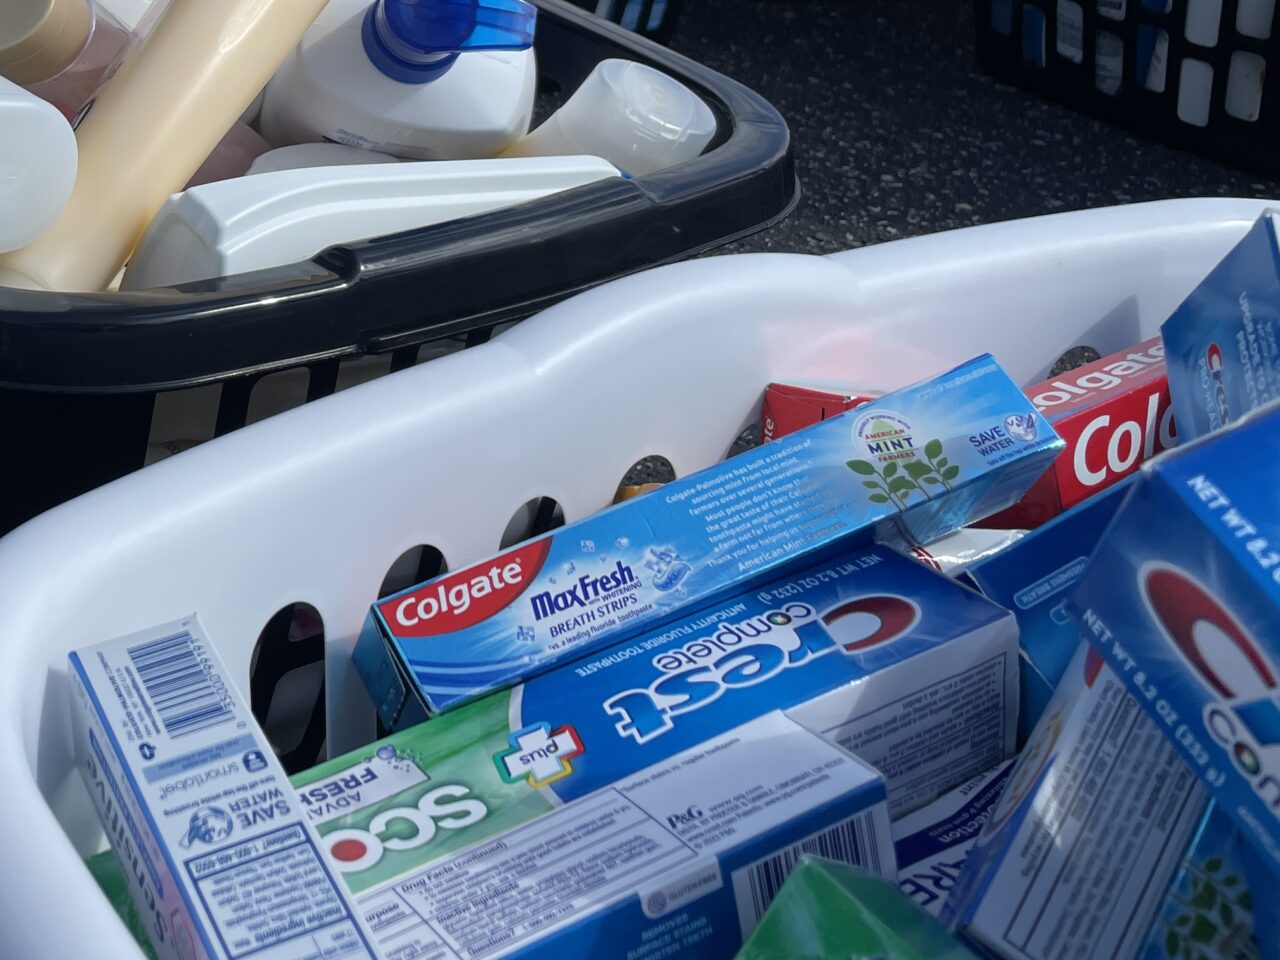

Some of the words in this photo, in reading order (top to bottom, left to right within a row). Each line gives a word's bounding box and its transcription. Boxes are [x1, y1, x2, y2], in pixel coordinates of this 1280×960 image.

[864, 427, 905, 440] AMERICAN
[867, 436, 913, 454] MINT
[967, 424, 1006, 448] SAVE
[976, 436, 1015, 457] WATER
[732, 465, 747, 476] has
[769, 442, 803, 461] tradition
[801, 438, 812, 448] of
[878, 450, 915, 463] FARMERS
[688, 498, 721, 517] farmers
[719, 492, 737, 504] over
[736, 480, 764, 497] several
[691, 486, 725, 505] sourcing
[724, 478, 743, 491] mint
[741, 471, 762, 484] from
[760, 462, 780, 475] local
[704, 509, 725, 522] Most
[724, 498, 752, 515] people
[705, 521, 721, 533] the
[720, 513, 741, 528] great
[739, 505, 761, 519] taste
[760, 501, 770, 511] of
[1185, 470, 1229, 515] NET
[1219, 505, 1256, 544] WT
[707, 520, 752, 543] toothpaste
[750, 510, 775, 527] might
[738, 531, 752, 542] not
[751, 526, 764, 537] far
[763, 518, 783, 532] from
[706, 552, 732, 568] Thank
[731, 547, 747, 559] you
[745, 540, 760, 552] for
[759, 528, 790, 547] helping
[736, 545, 785, 572] American
[858, 550, 882, 568] NET
[837, 559, 858, 576] WT
[395, 558, 523, 627] Colgate
[530, 561, 639, 621] MaxFresh
[601, 580, 643, 601] WHITENING
[549, 613, 594, 638] BREATH
[596, 592, 638, 622] STRIPS
[565, 629, 591, 644] leading
[589, 618, 617, 633] fluoride
[616, 603, 653, 623] toothpaste
[689, 601, 747, 631] ANTICAVITY
[642, 623, 693, 651] FLUORIDE
[654, 602, 815, 672] complete
[1079, 608, 1112, 644] NET
[1107, 641, 1136, 672] WT
[574, 637, 658, 678] TOOTHPASTE
[604, 594, 918, 743] Crest
[518, 740, 558, 766] plus
[227, 785, 283, 812] WATER
[236, 798, 291, 830] SAVE
[665, 802, 704, 830] P&G
[425, 863, 454, 881] Facts
